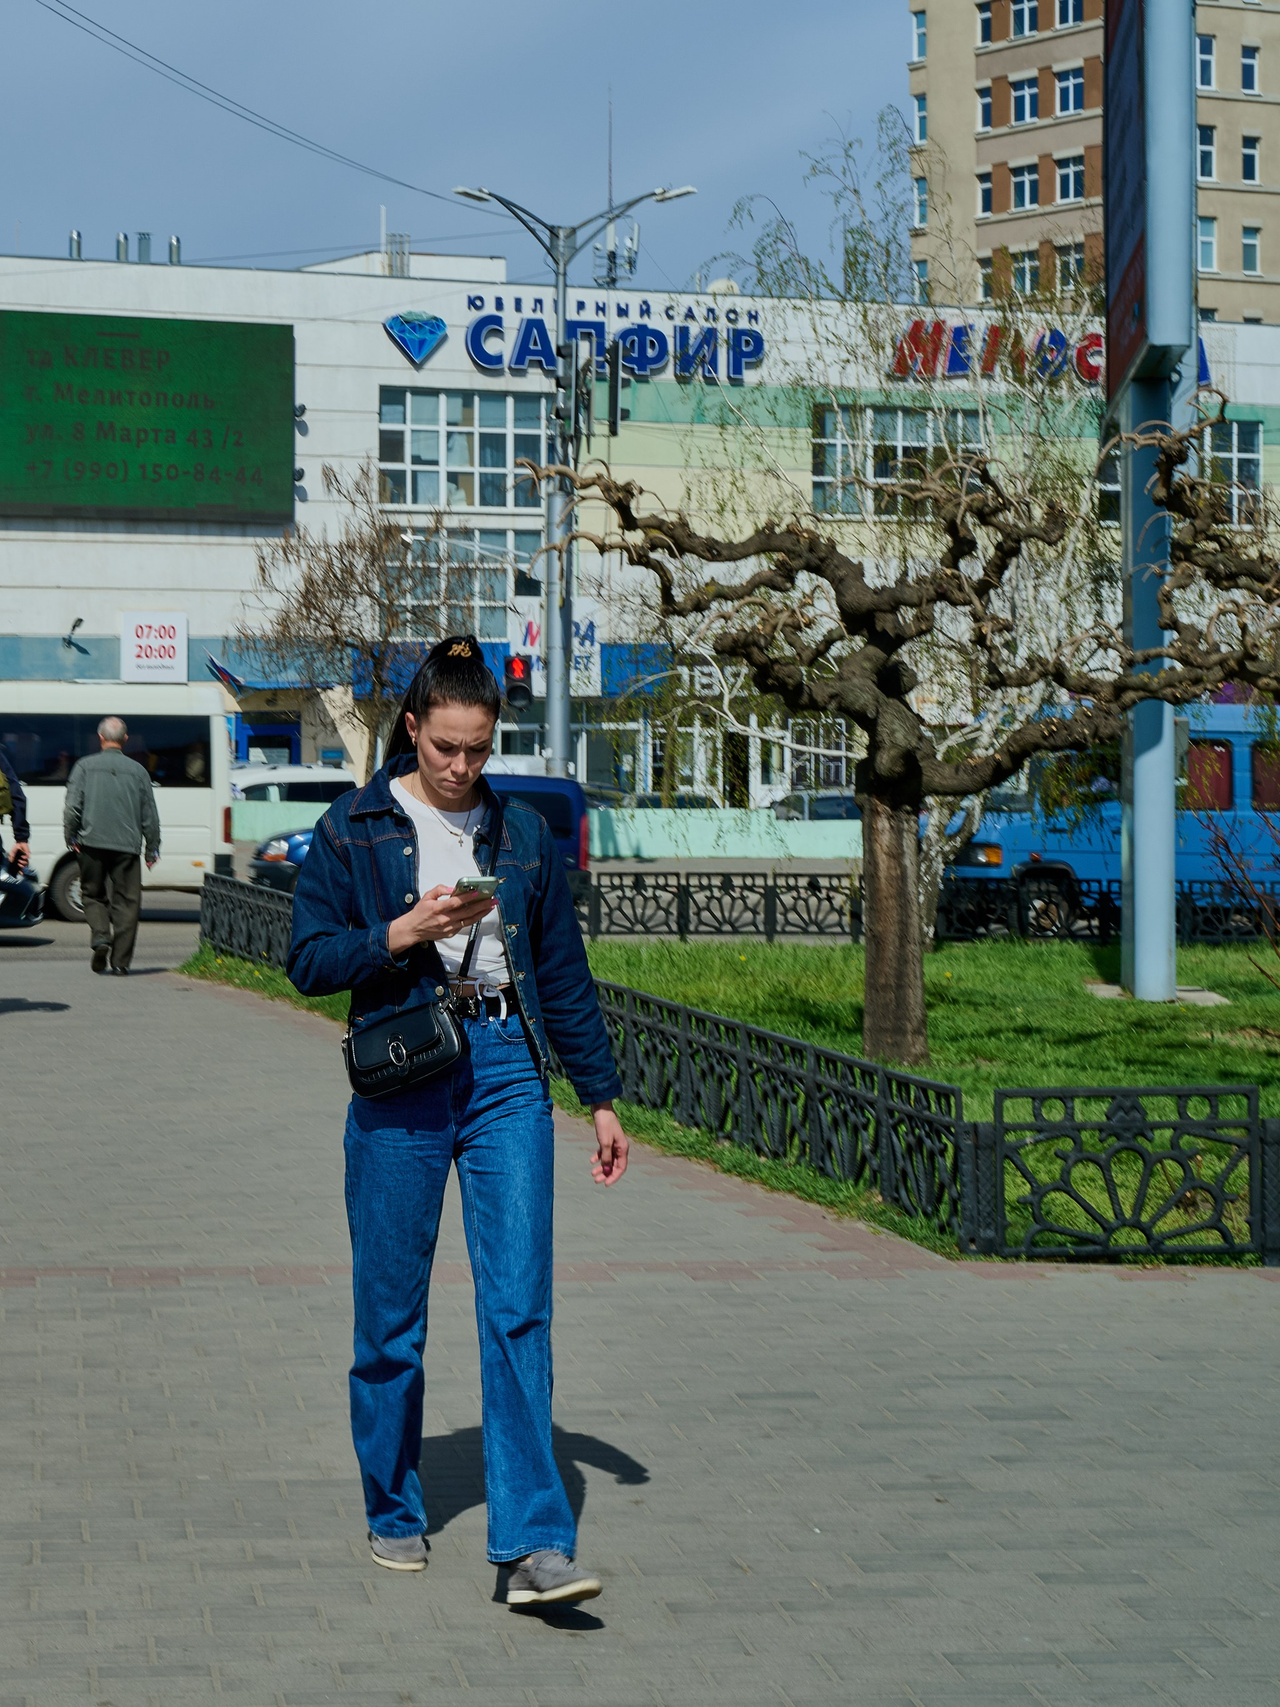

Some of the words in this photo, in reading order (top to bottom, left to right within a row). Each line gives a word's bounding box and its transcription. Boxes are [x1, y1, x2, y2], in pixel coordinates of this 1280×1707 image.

[664, 304, 760, 326] САЛОН
[63, 343, 171, 371] КЛЕВЕР
[465, 313, 766, 378] САПФИР
[52, 381, 217, 410] Мелитополь
[24, 422, 63, 446] ул.
[72, 421, 86, 442] 8
[95, 420, 178, 448] Марта
[186, 427, 214, 450] 43
[25, 459, 53, 480] +7
[63, 458, 130, 484] (990)
[138, 461, 264, 487] 150-84-44
[135, 624, 177, 640] 07:00
[135, 644, 177, 660] 20:00
